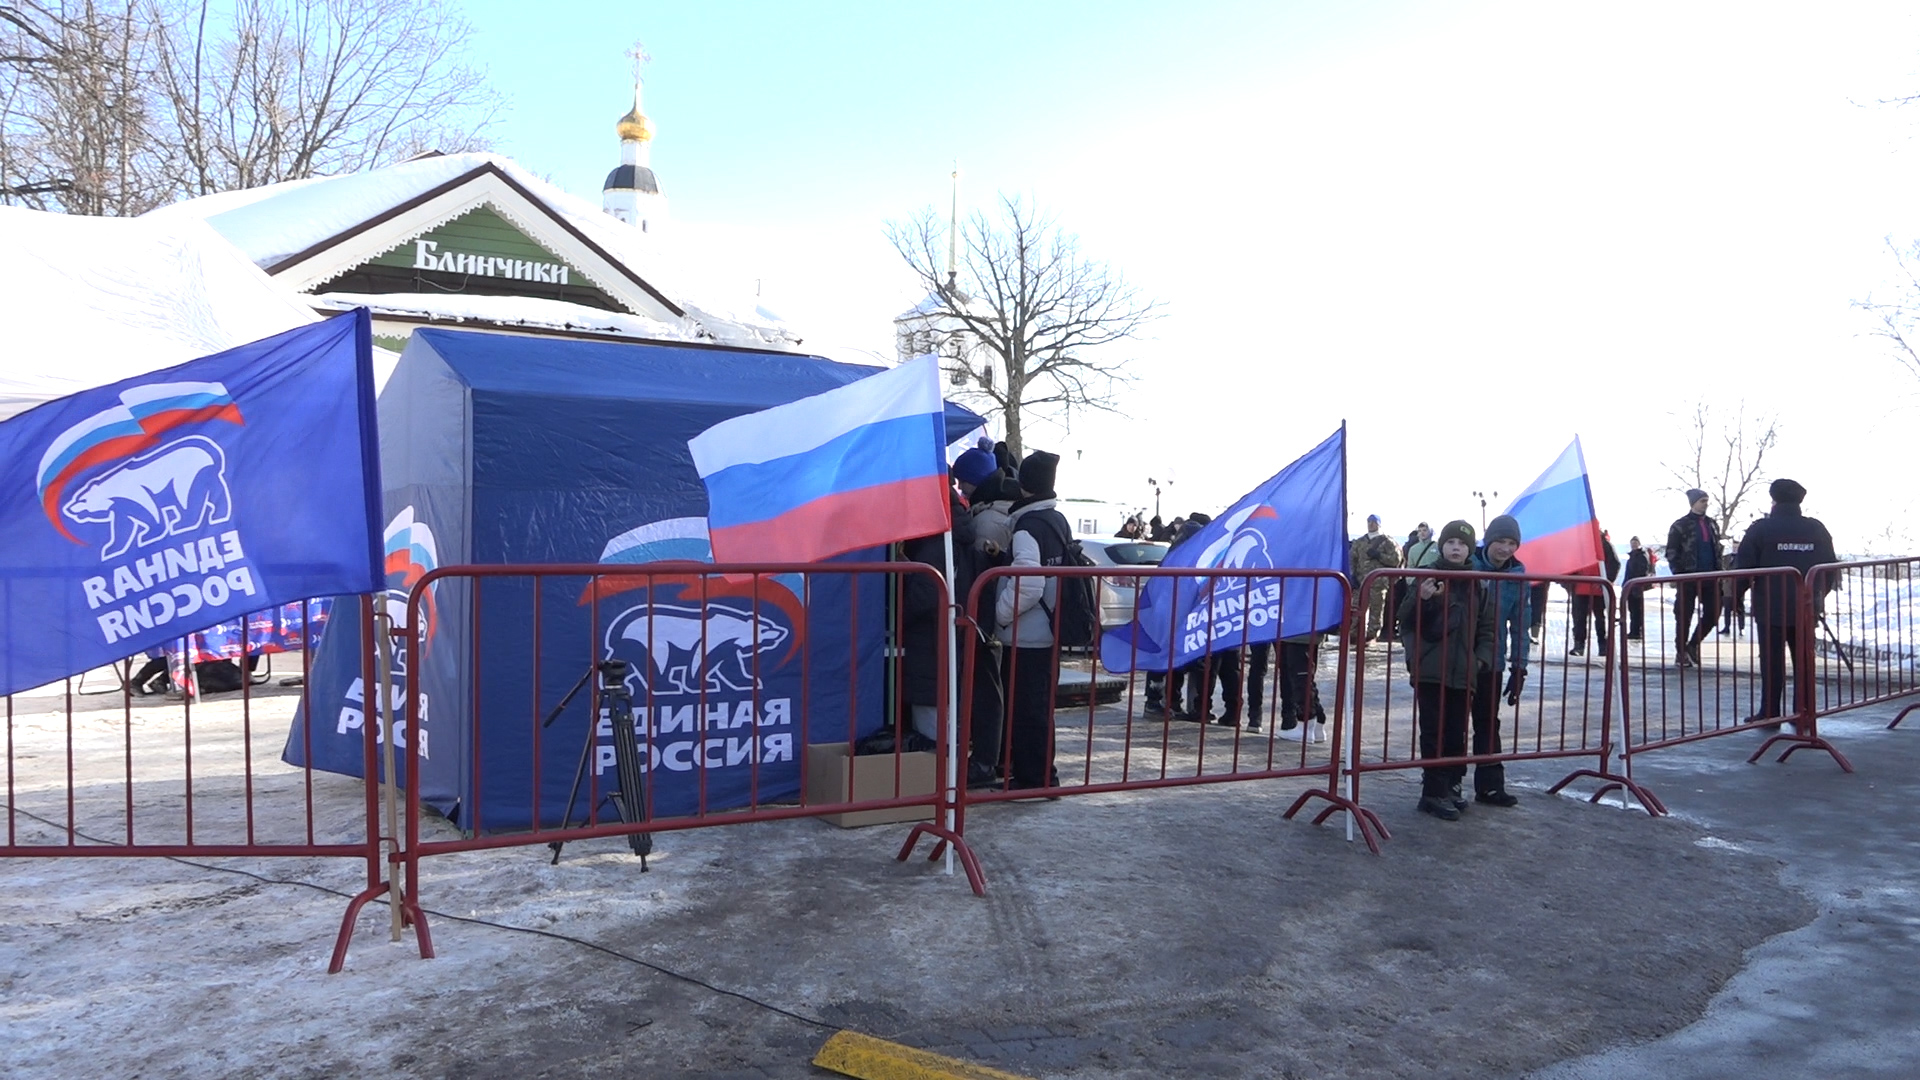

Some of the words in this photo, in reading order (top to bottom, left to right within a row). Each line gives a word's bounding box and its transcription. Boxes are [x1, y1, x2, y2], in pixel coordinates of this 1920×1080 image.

[412, 239, 569, 285] Блинчики
[1776, 542, 1815, 552] ПОЛИЦИЯ
[596, 698, 791, 738] ЕДИНАЯ
[590, 732, 793, 777] РОССИЯ
